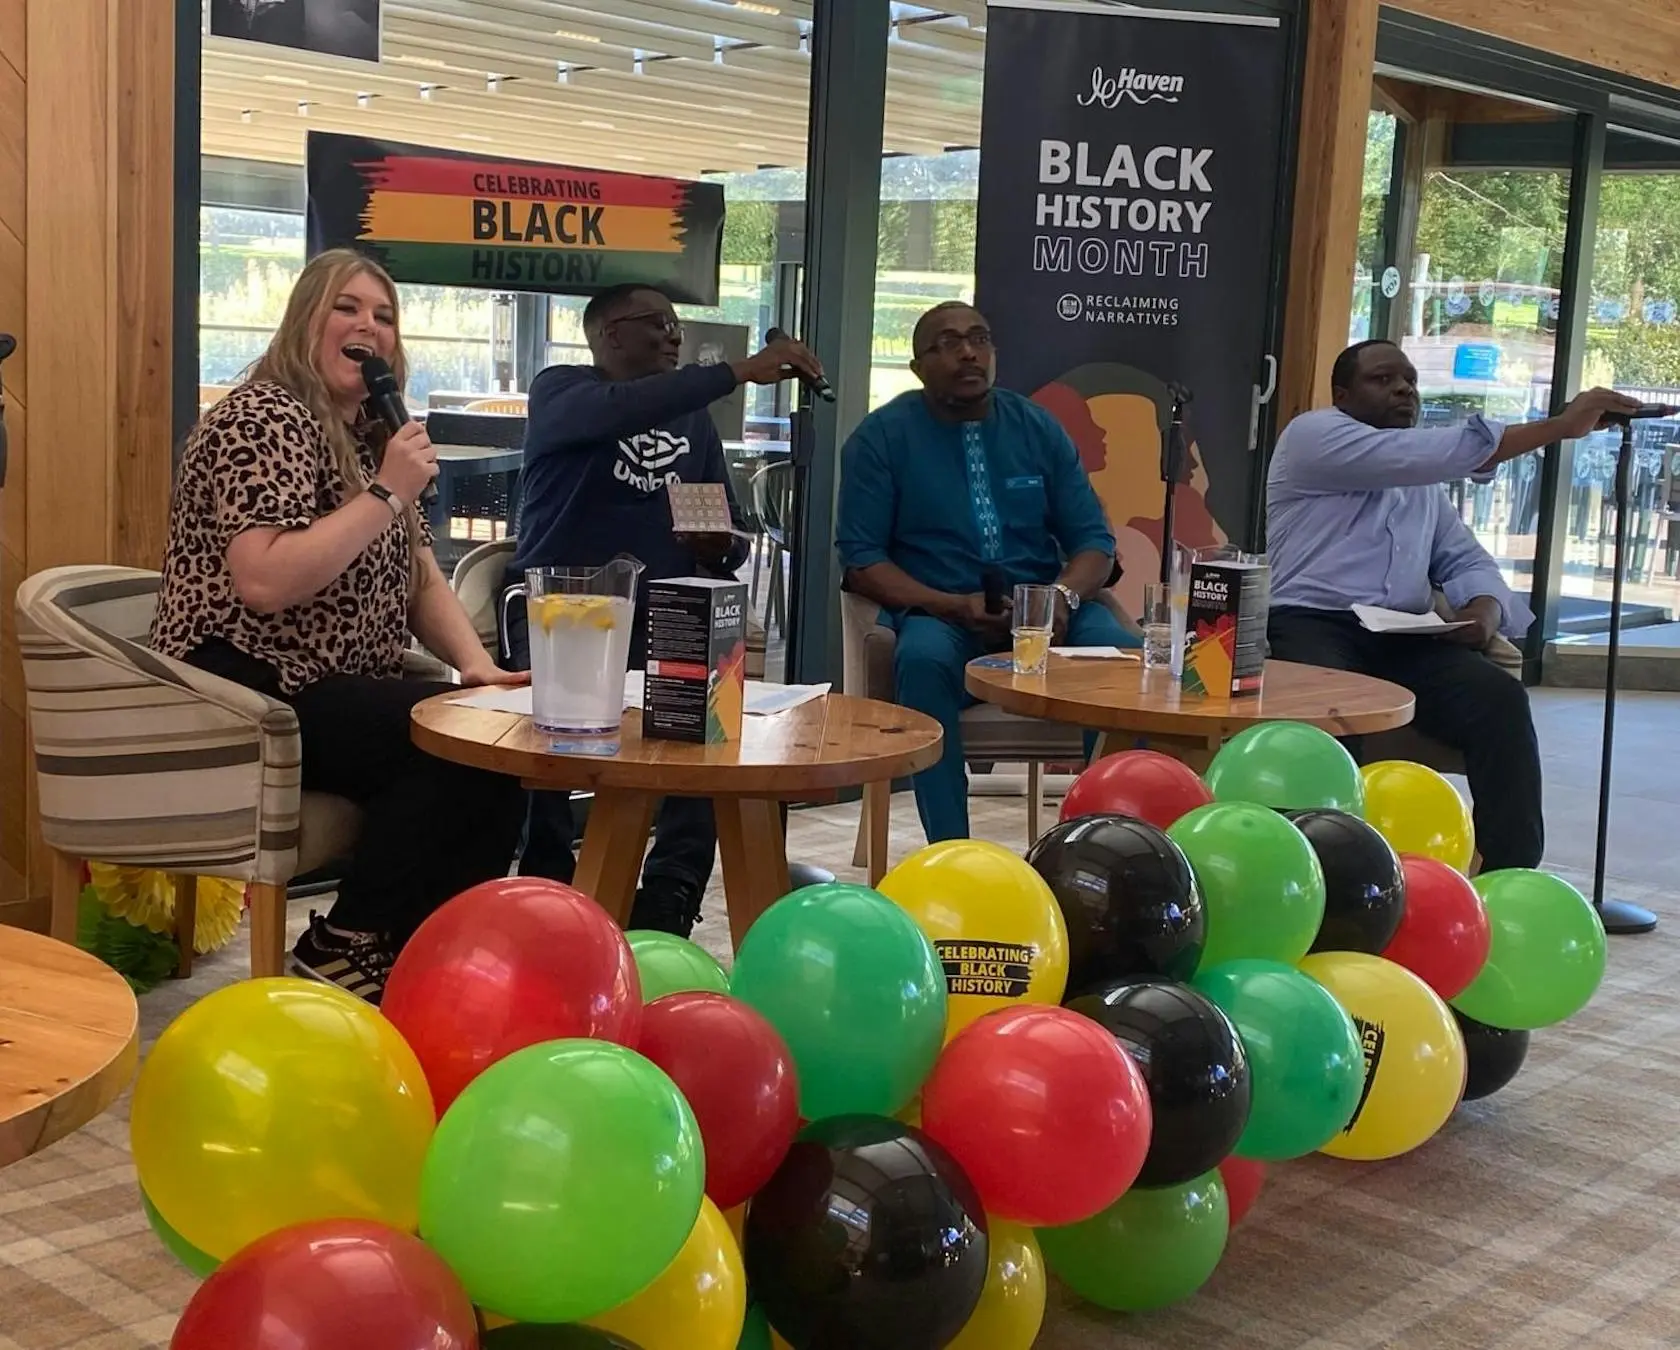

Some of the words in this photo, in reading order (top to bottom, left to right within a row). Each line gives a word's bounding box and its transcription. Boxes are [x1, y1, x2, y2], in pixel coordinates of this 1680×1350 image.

[1118, 68, 1184, 92] Haven
[1038, 139, 1214, 191] BLACK
[473, 173, 600, 198] CELEBRATING
[1035, 193, 1212, 233] HISTORY
[473, 199, 606, 245] BLACK
[1033, 236, 1209, 278] MONTH
[472, 249, 604, 283] HISTORY
[1085, 294, 1179, 311] RECLAIMING
[1085, 311, 1179, 326] NARRATIVES
[1194, 580, 1228, 593] BLACK
[1193, 590, 1228, 601] HISTORY
[715, 604, 740, 618] BLACK
[937, 946, 1029, 962] CELEBRATING
[960, 961, 1007, 977] BLACK
[951, 979, 1013, 994] HISTORY
